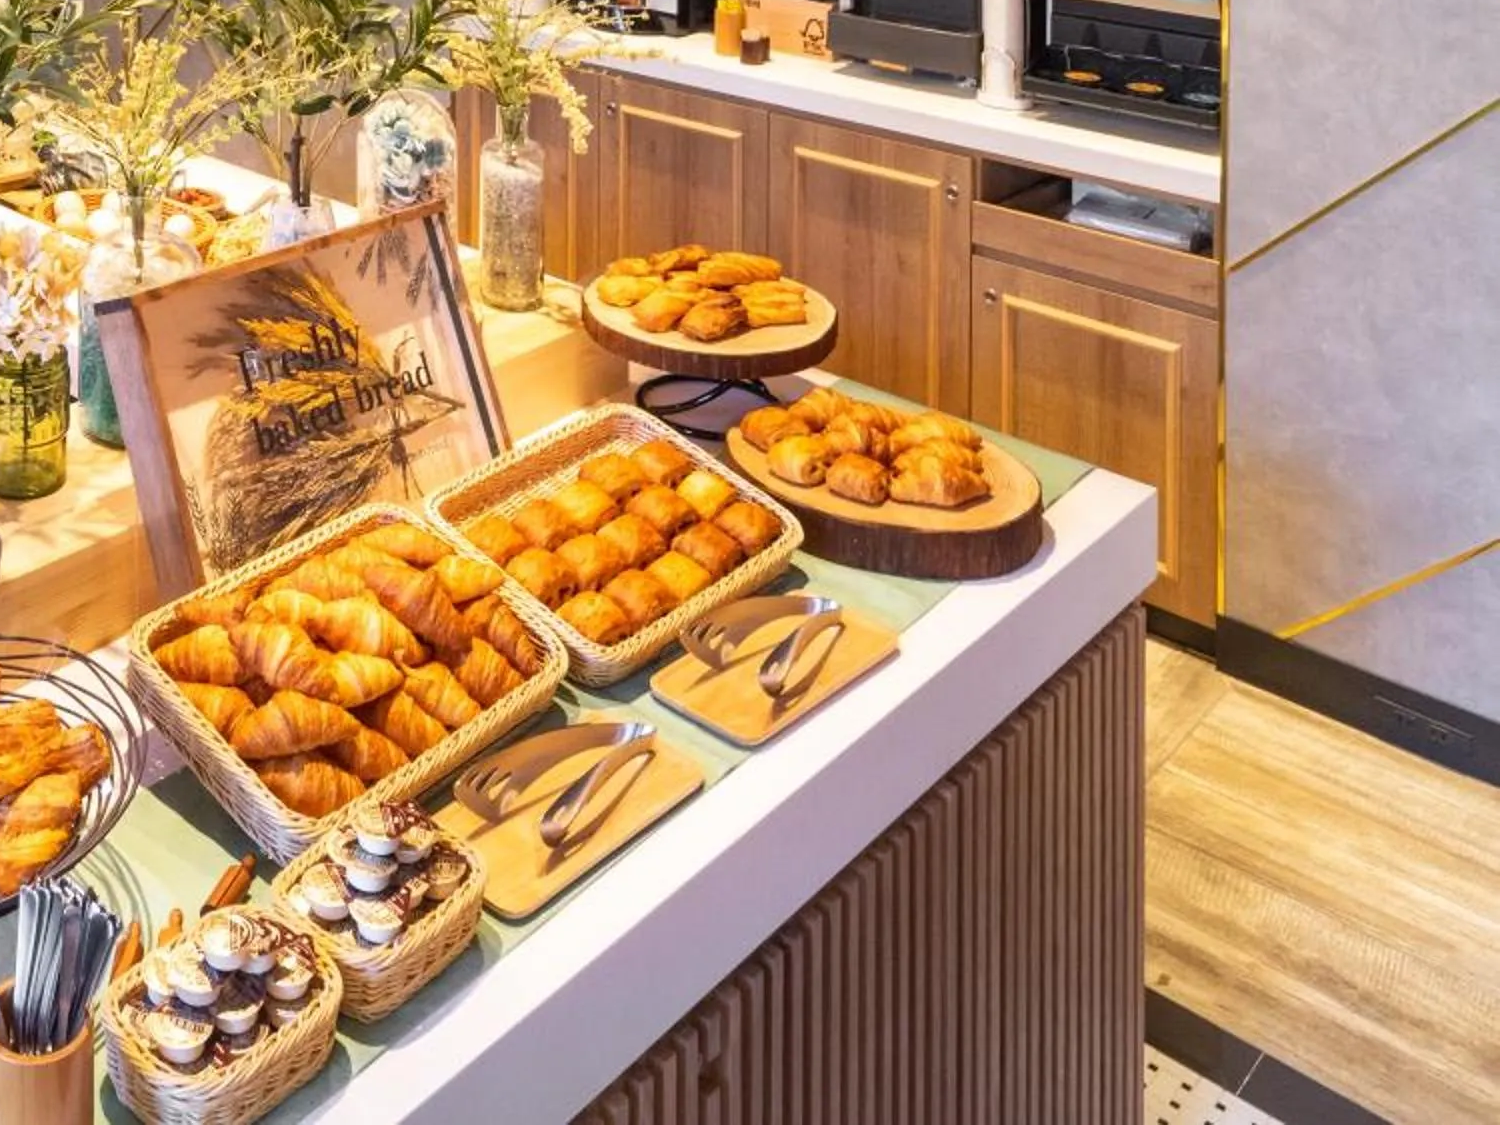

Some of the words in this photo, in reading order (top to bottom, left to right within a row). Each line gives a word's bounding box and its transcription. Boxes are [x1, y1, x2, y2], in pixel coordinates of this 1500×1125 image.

[238, 317, 360, 395] Freshly
[251, 385, 347, 456] baked
[354, 350, 434, 415] bread
